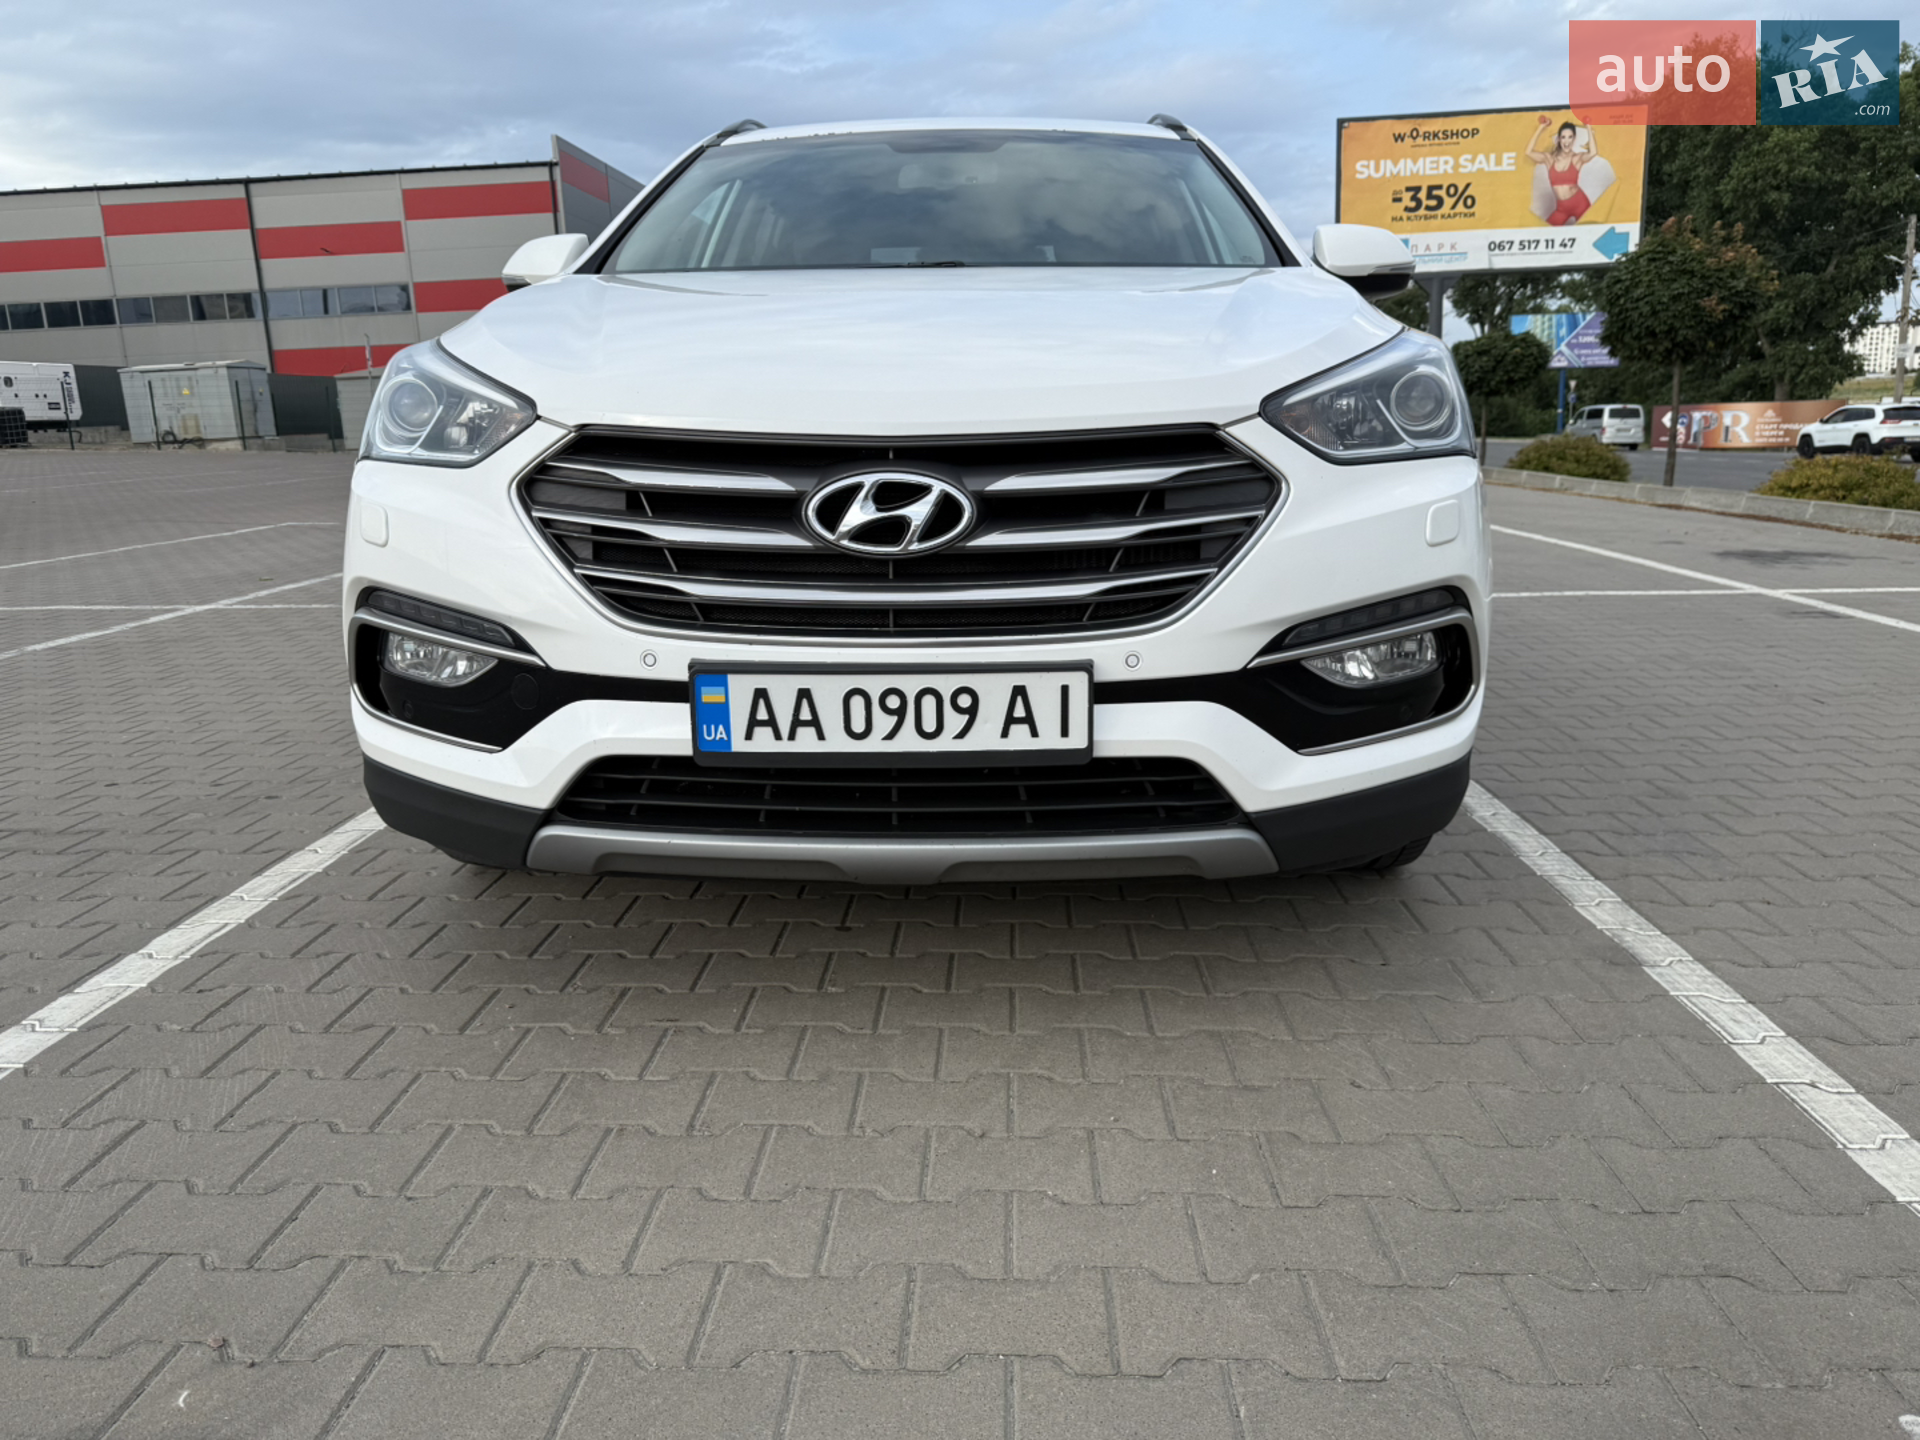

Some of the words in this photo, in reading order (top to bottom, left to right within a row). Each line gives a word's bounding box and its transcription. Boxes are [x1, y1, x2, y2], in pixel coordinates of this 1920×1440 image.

[1393, 127, 1480, 143] WORKSHOP
[1355, 155, 1454, 179] SUMMER
[1458, 152, 1516, 173] SALE
[1392, 182, 1476, 213] -35%
[1406, 213, 1438, 221] КЛУБНІ
[1440, 211, 1476, 219] КАРТКИ
[1488, 240, 1514, 252] 067
[1518, 239, 1540, 251] 517
[1544, 239, 1555, 249] 11
[1559, 237, 1576, 249] 47
[744, 687, 827, 741] AA
[842, 686, 980, 740] 0909
[703, 724, 728, 741] UA
